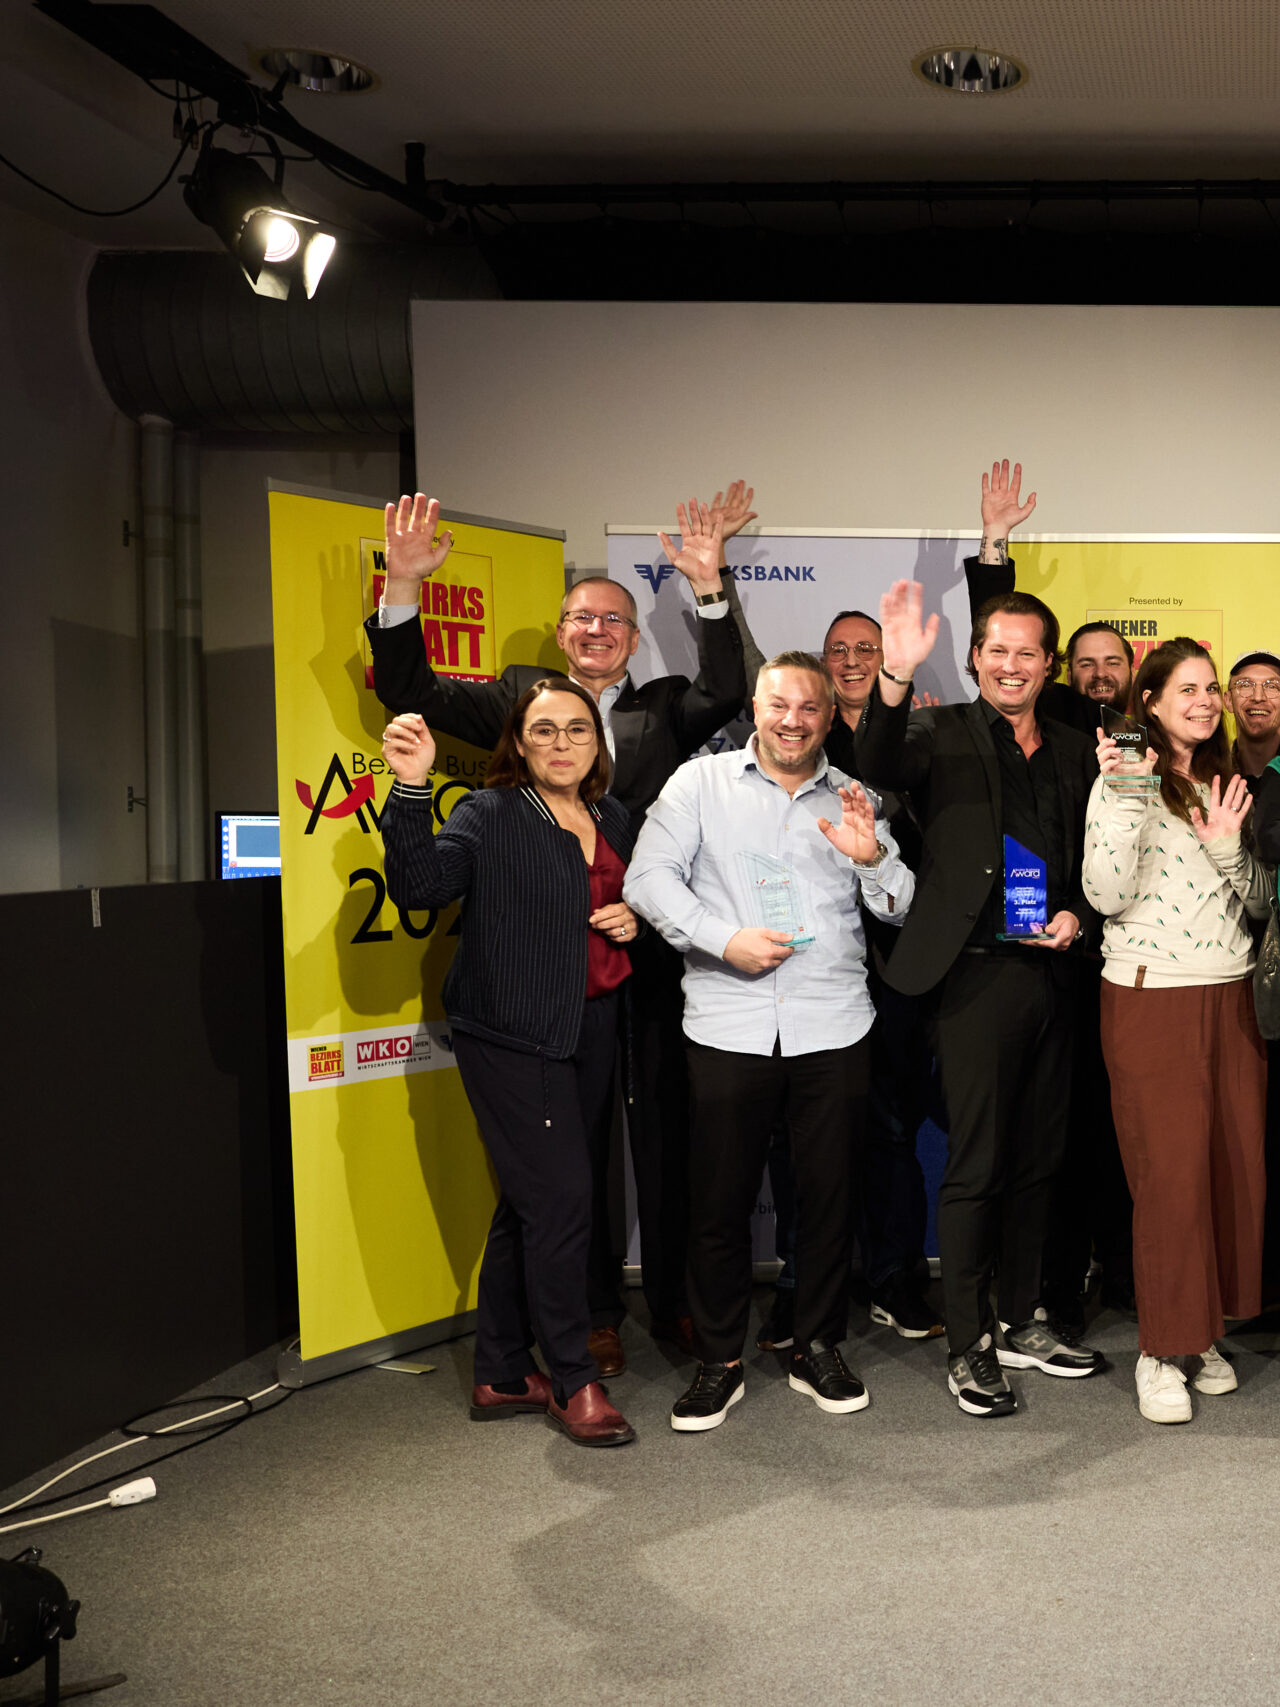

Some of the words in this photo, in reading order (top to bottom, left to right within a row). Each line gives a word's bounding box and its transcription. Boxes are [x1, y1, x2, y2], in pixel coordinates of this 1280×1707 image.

[728, 565, 816, 582] KSBANK
[372, 574, 485, 621] BIRKS
[1129, 597, 1171, 605] Presented
[1173, 597, 1183, 606] by
[423, 618, 485, 668] ATT
[1010, 868, 1040, 878] Award
[310, 1050, 342, 1062] BEZIRKS
[358, 1039, 410, 1060] WKO
[311, 1059, 342, 1075] BLATT
[357, 1058, 417, 1070] WIRTSCHAFTSKAMMER
